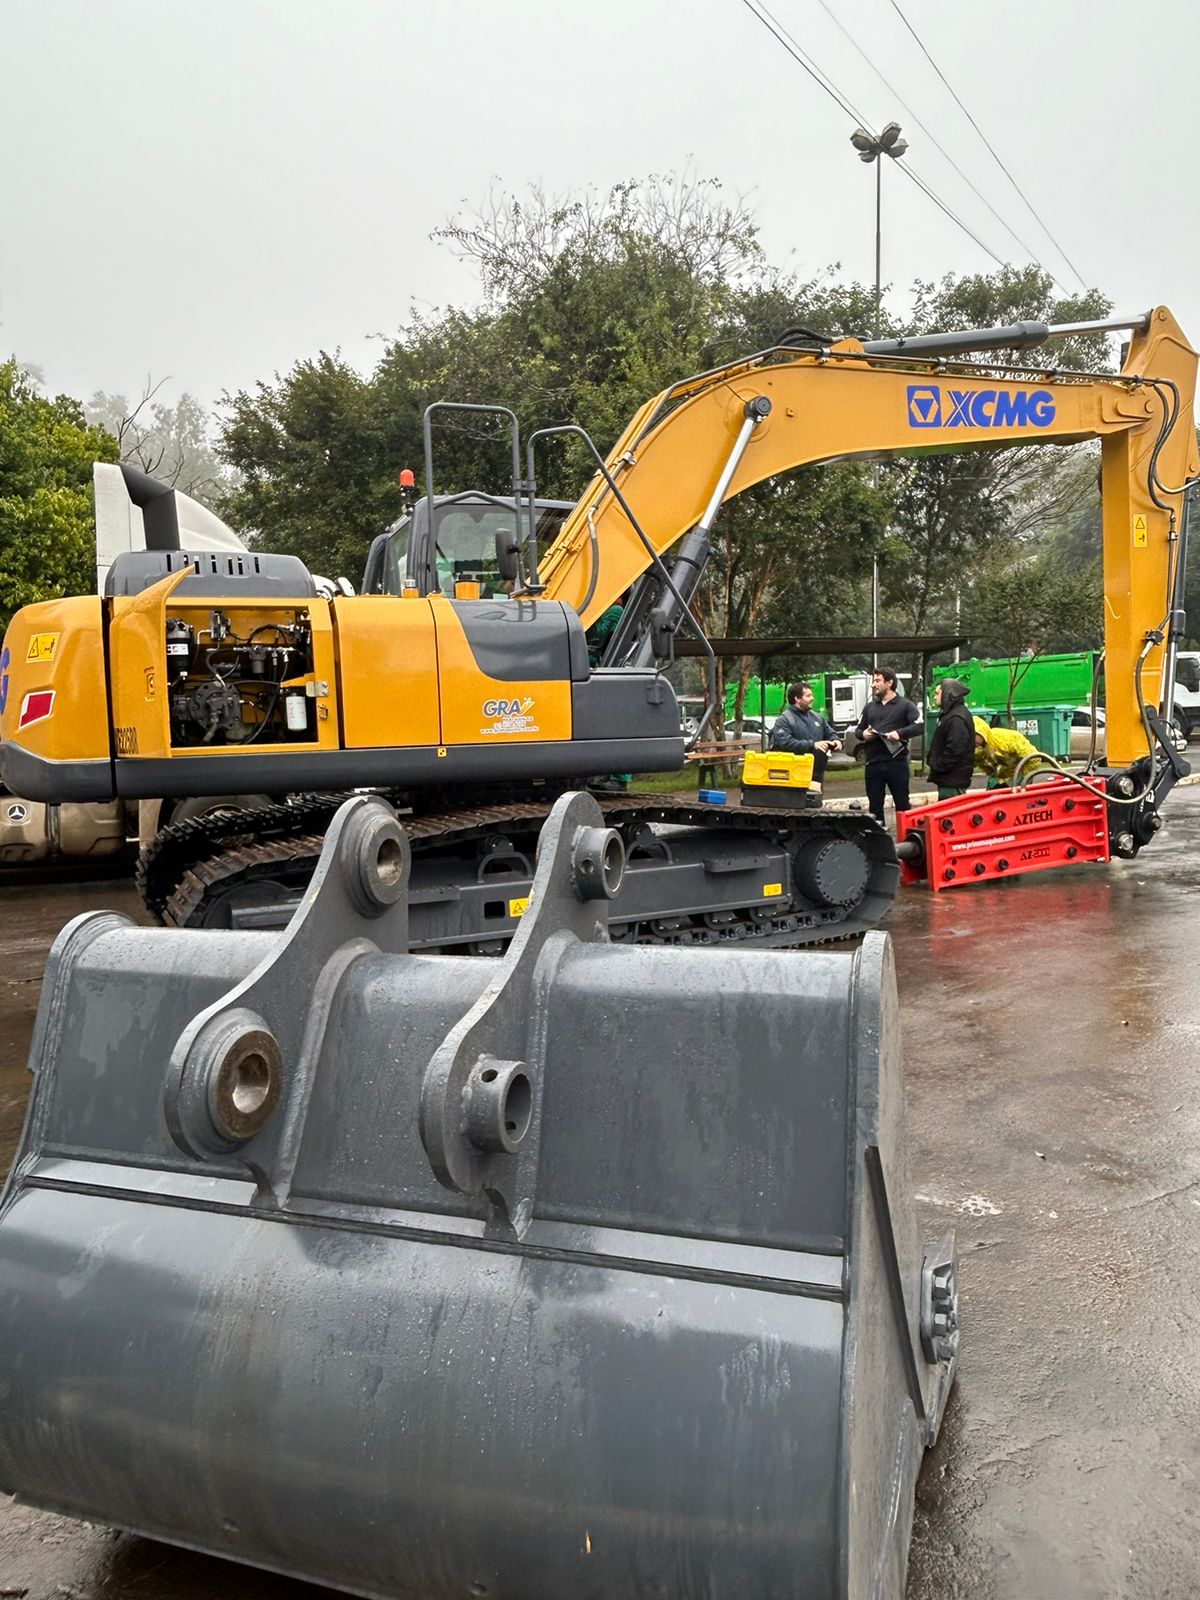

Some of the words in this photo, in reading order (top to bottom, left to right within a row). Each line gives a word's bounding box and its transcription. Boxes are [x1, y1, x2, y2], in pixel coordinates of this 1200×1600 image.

[943, 389, 1056, 428] XCMG
[483, 699, 521, 717] GRA
[1013, 810, 1053, 826] AZTECH
